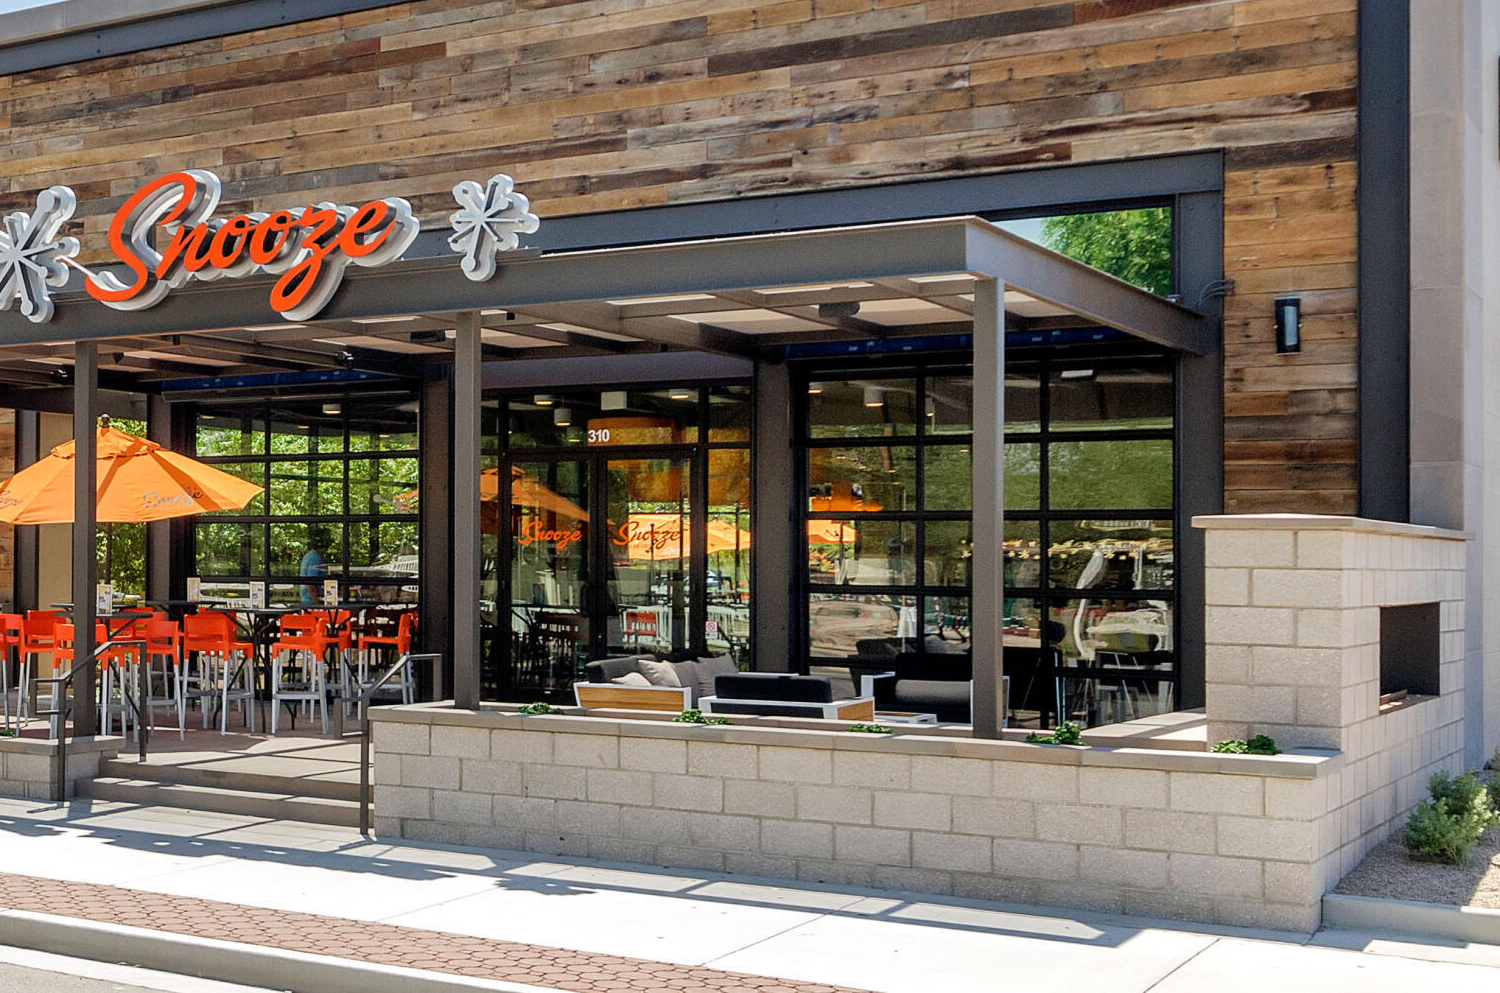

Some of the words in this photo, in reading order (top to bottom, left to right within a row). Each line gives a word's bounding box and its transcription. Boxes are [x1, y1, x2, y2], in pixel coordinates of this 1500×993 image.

[85, 169, 412, 320] Snooze
[587, 428, 611, 443] 310
[518, 520, 582, 551] Snooze
